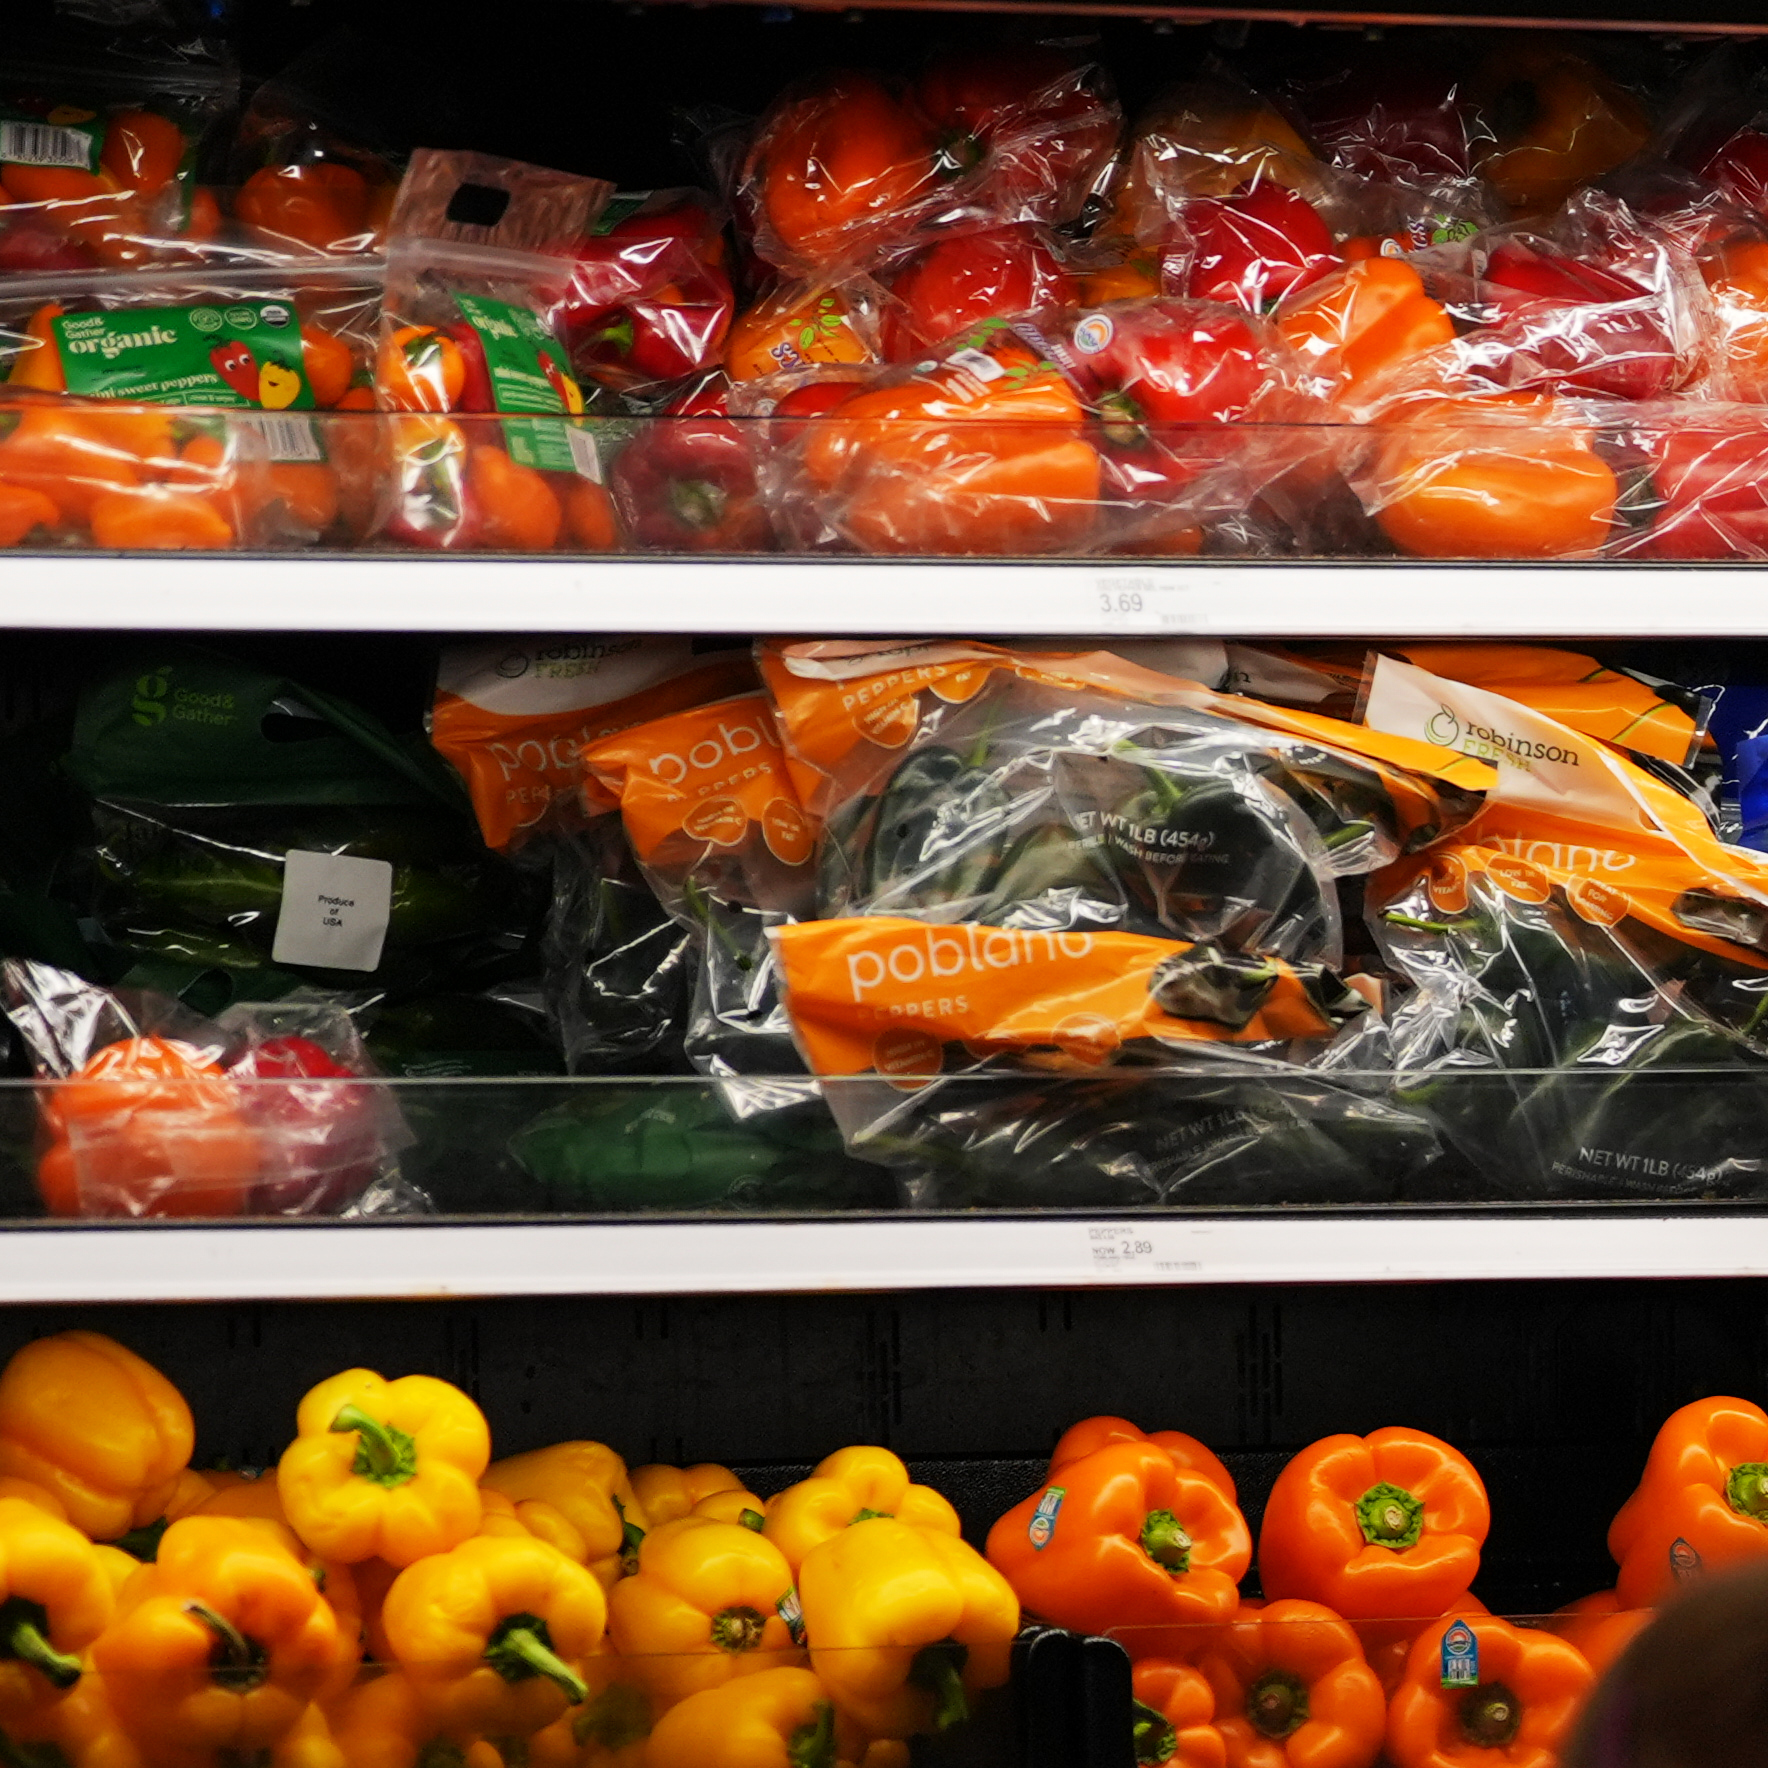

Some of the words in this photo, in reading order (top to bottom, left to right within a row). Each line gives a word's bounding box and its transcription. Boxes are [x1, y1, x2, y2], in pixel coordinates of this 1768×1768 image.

[68, 325, 178, 359] organic
[117, 381, 159, 397] sweet
[161, 373, 219, 392] peppers
[1100, 593, 1143, 612] 3.69
[842, 664, 948, 712] PEPPERS
[1462, 738, 1533, 773] FRESH
[1466, 721, 1580, 766] robinson
[1100, 811, 1127, 831] WT
[1128, 824, 1156, 844] 1LB
[318, 894, 355, 907] Produce
[330, 907, 339, 916] of
[322, 916, 342, 927] USA
[847, 923, 1096, 1004] poblano
[1579, 1146, 1615, 1167] NET
[1616, 1152, 1640, 1171] WT
[1643, 1157, 1669, 1176] 1LB
[1120, 1240, 1153, 1254] 2.89
